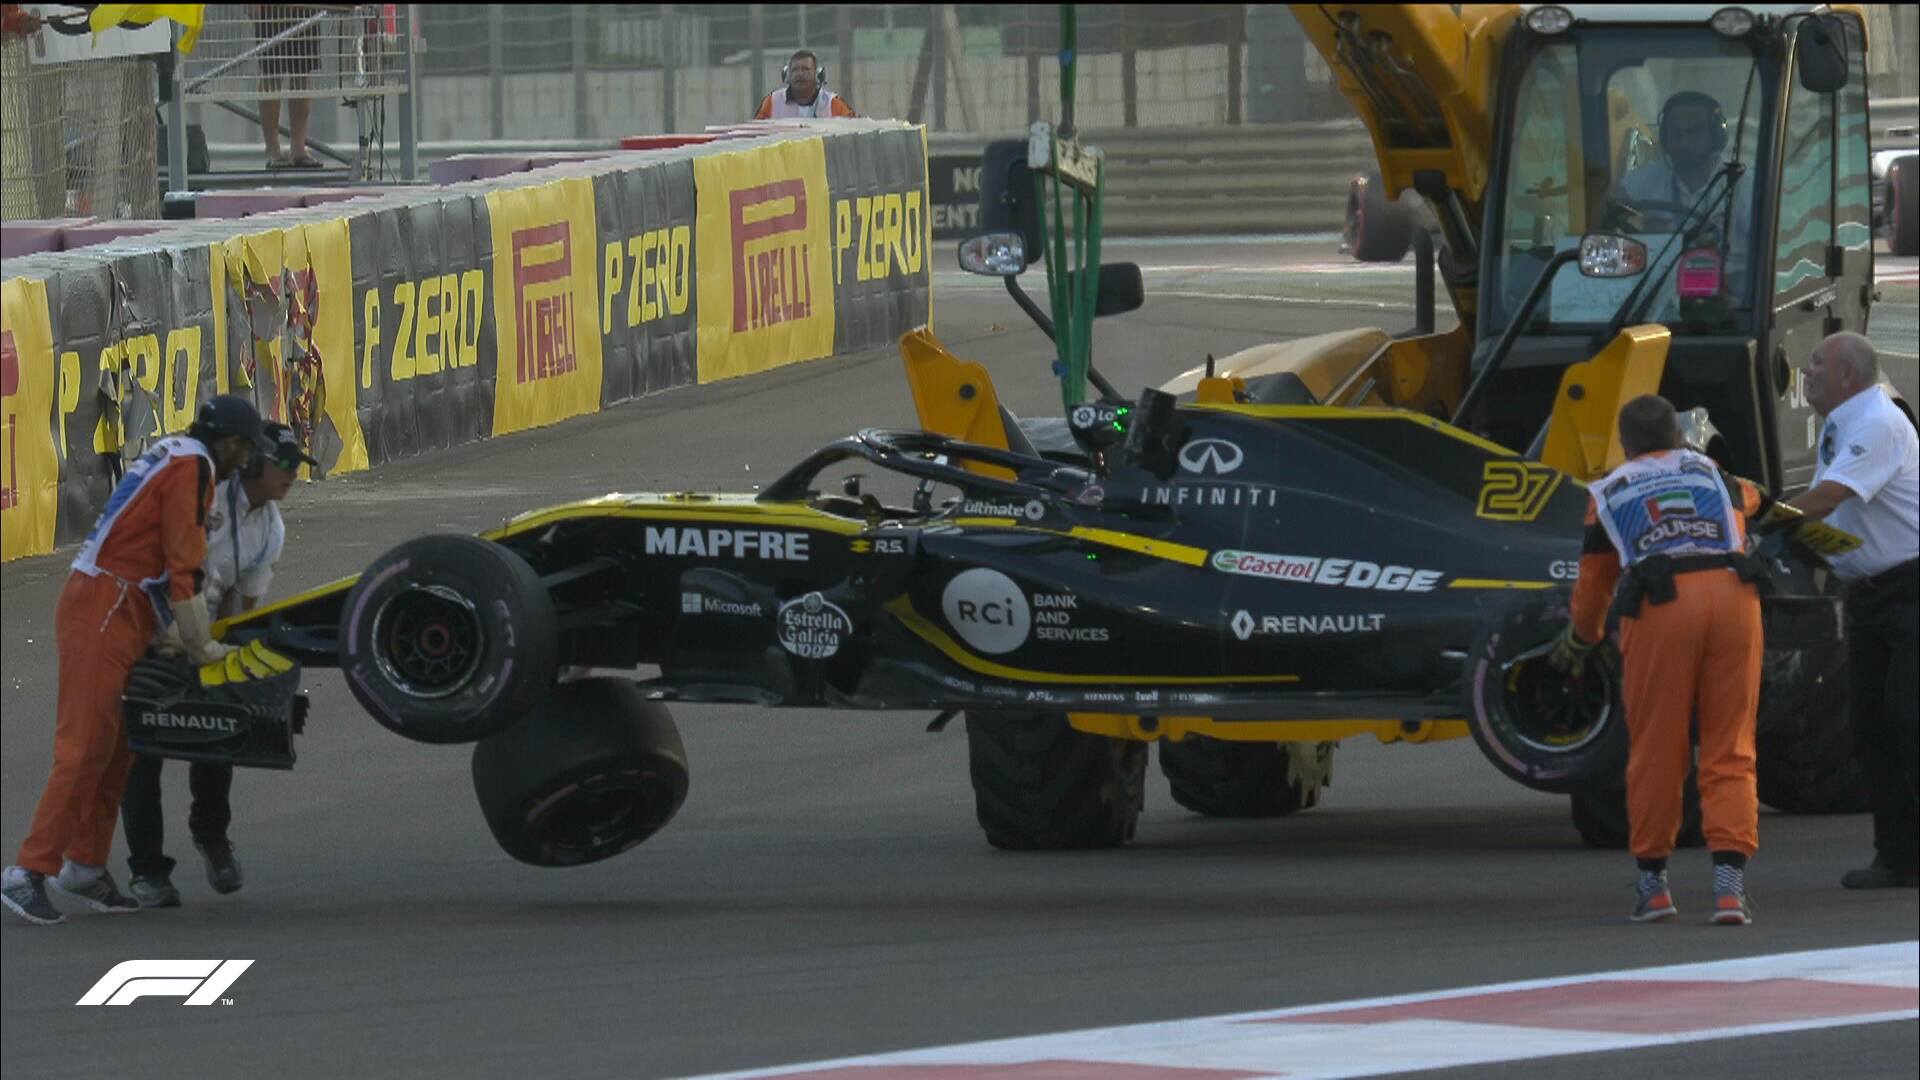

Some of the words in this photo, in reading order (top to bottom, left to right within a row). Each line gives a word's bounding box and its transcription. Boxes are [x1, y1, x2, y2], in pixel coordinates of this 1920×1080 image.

[836, 200, 851, 285] P
[857, 190, 921, 282] ZERO
[729, 178, 811, 332] PIRELLI
[604, 240, 623, 335] P
[627, 225, 690, 328] ZERO
[391, 269, 484, 381] ZERO
[59, 351, 81, 460] P
[1141, 487, 1277, 507] INFINITI
[1476, 461, 1563, 521] 27
[964, 502, 1025, 517] ultimate
[645, 526, 809, 561] MAPFRE
[1637, 519, 1719, 551] COURSE
[1237, 555, 1314, 579] Castrol
[1314, 558, 1444, 592] EDGE
[704, 598, 762, 617] Microsoft
[957, 597, 1014, 627] RCi
[1033, 594, 1077, 609] BANK
[784, 609, 842, 630] Estrella
[1035, 611, 1070, 625] AND
[1262, 613, 1386, 634] RENAULT
[786, 626, 839, 645] Galicia
[1037, 627, 1109, 642] SERVICES
[141, 712, 238, 733] RENAULT
